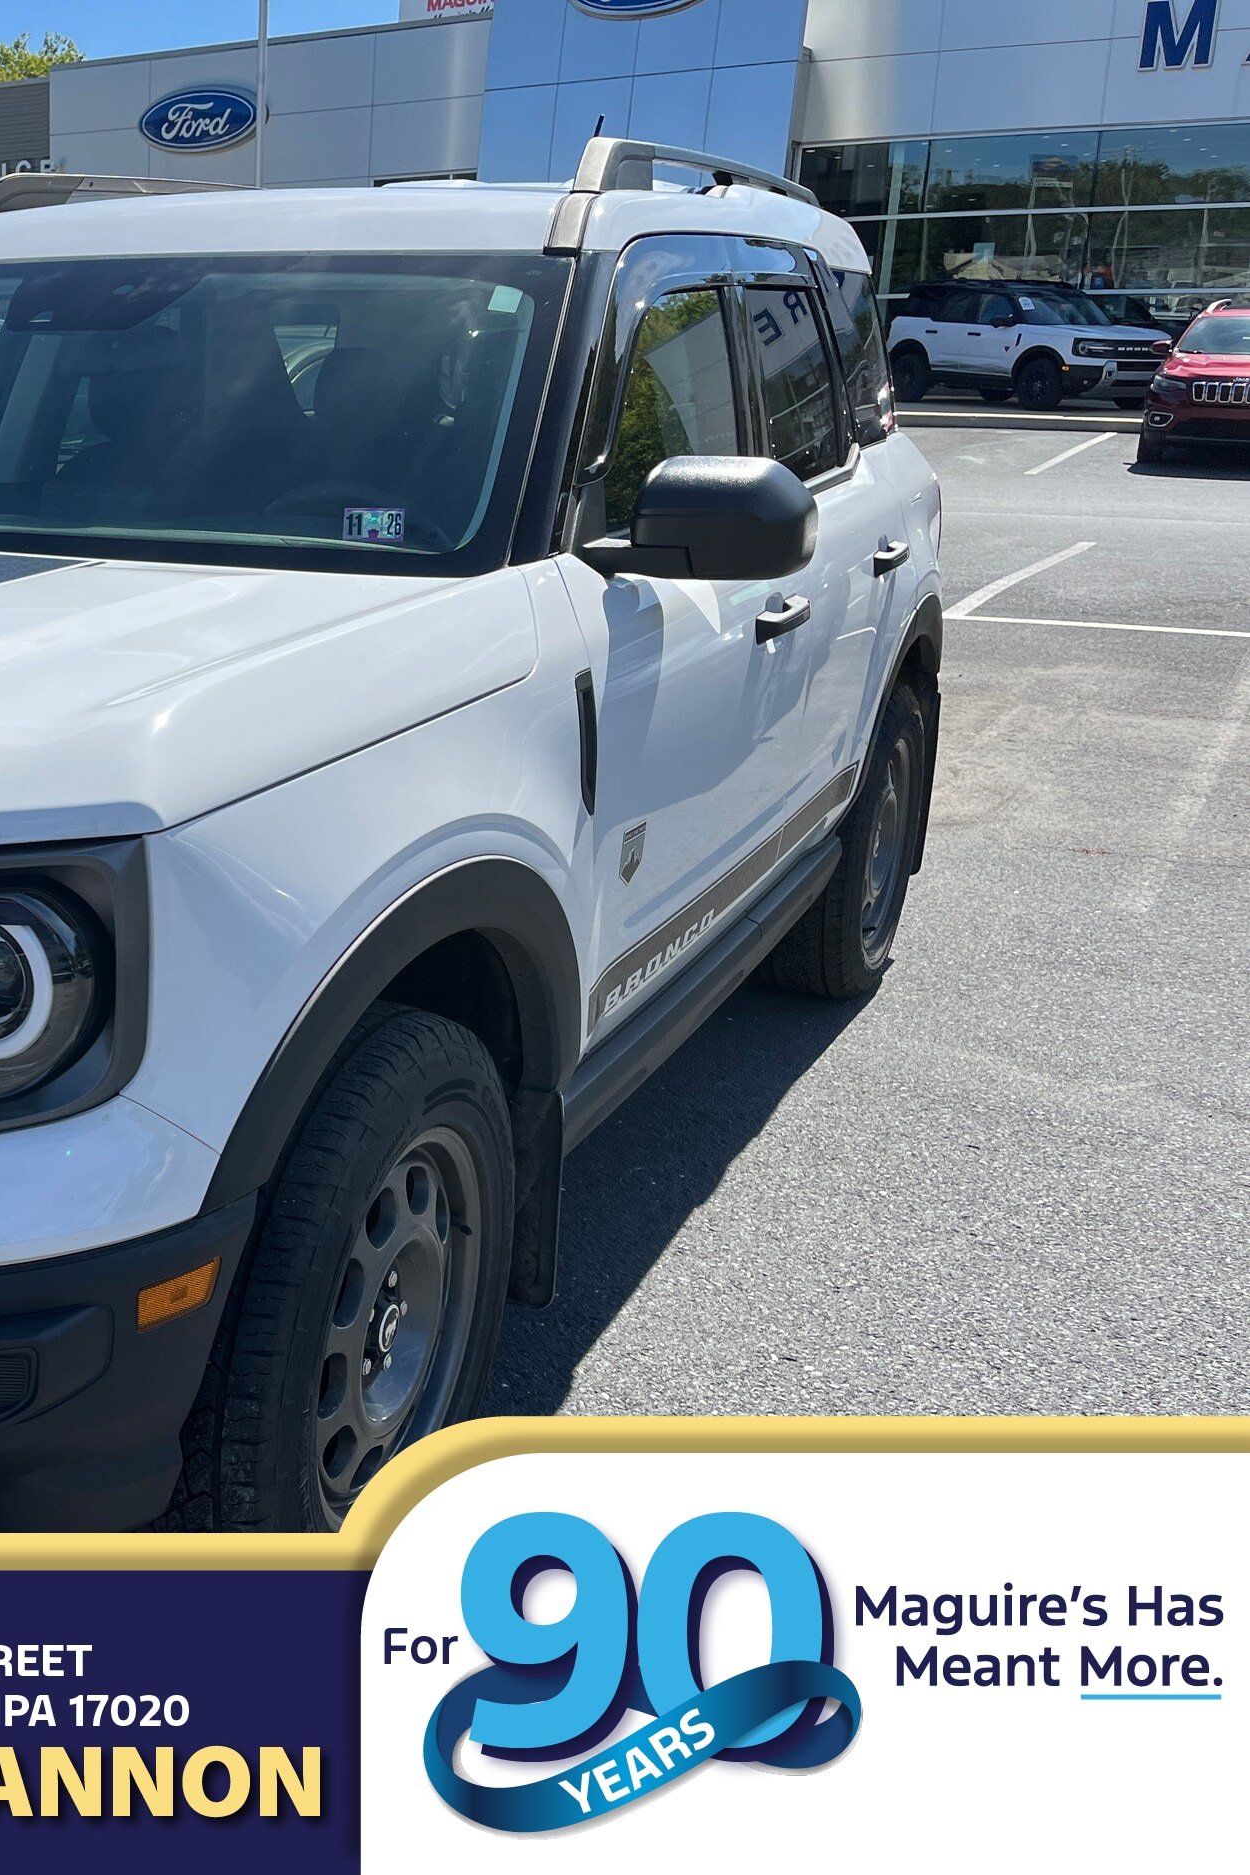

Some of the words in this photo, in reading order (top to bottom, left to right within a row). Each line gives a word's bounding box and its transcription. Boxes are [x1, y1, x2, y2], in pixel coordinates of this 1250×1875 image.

[1137, 0, 1250, 72] M
[161, 102, 231, 139] Ford
[346, 513, 363, 536] 11
[386, 513, 402, 536] 26
[603, 907, 716, 1014] BRONCO
